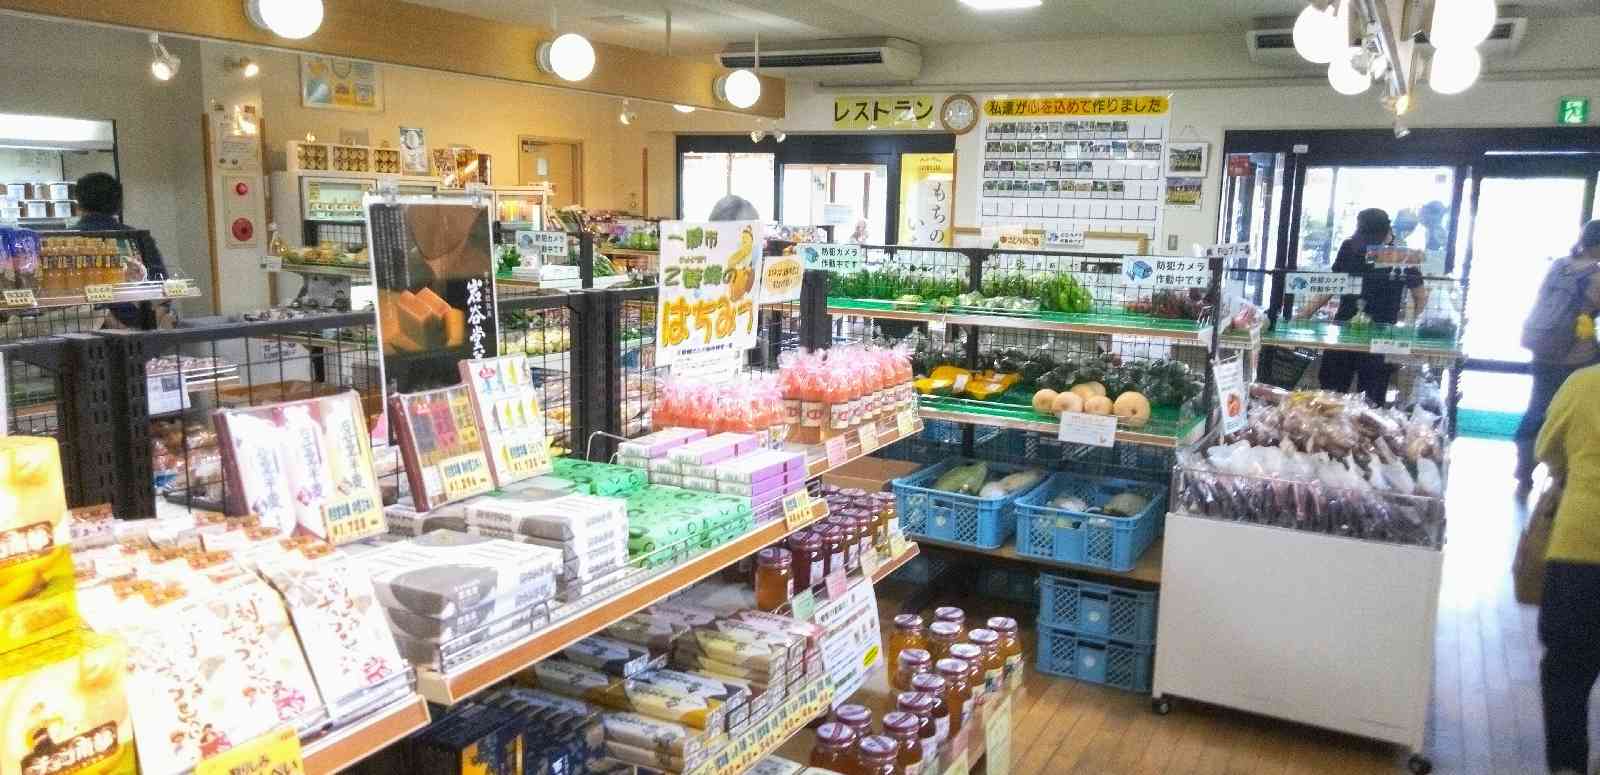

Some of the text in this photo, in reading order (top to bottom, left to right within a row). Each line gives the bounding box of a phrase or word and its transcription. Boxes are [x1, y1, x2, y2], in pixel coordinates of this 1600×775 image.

[834, 101, 933, 122] レストラン
[821, 247, 858, 257] 防犯カメラ
[821, 259, 857, 268] 作動中です
[1156, 260, 1206, 272] 防犯カメラ
[1156, 274, 1206, 285] 作動中です
